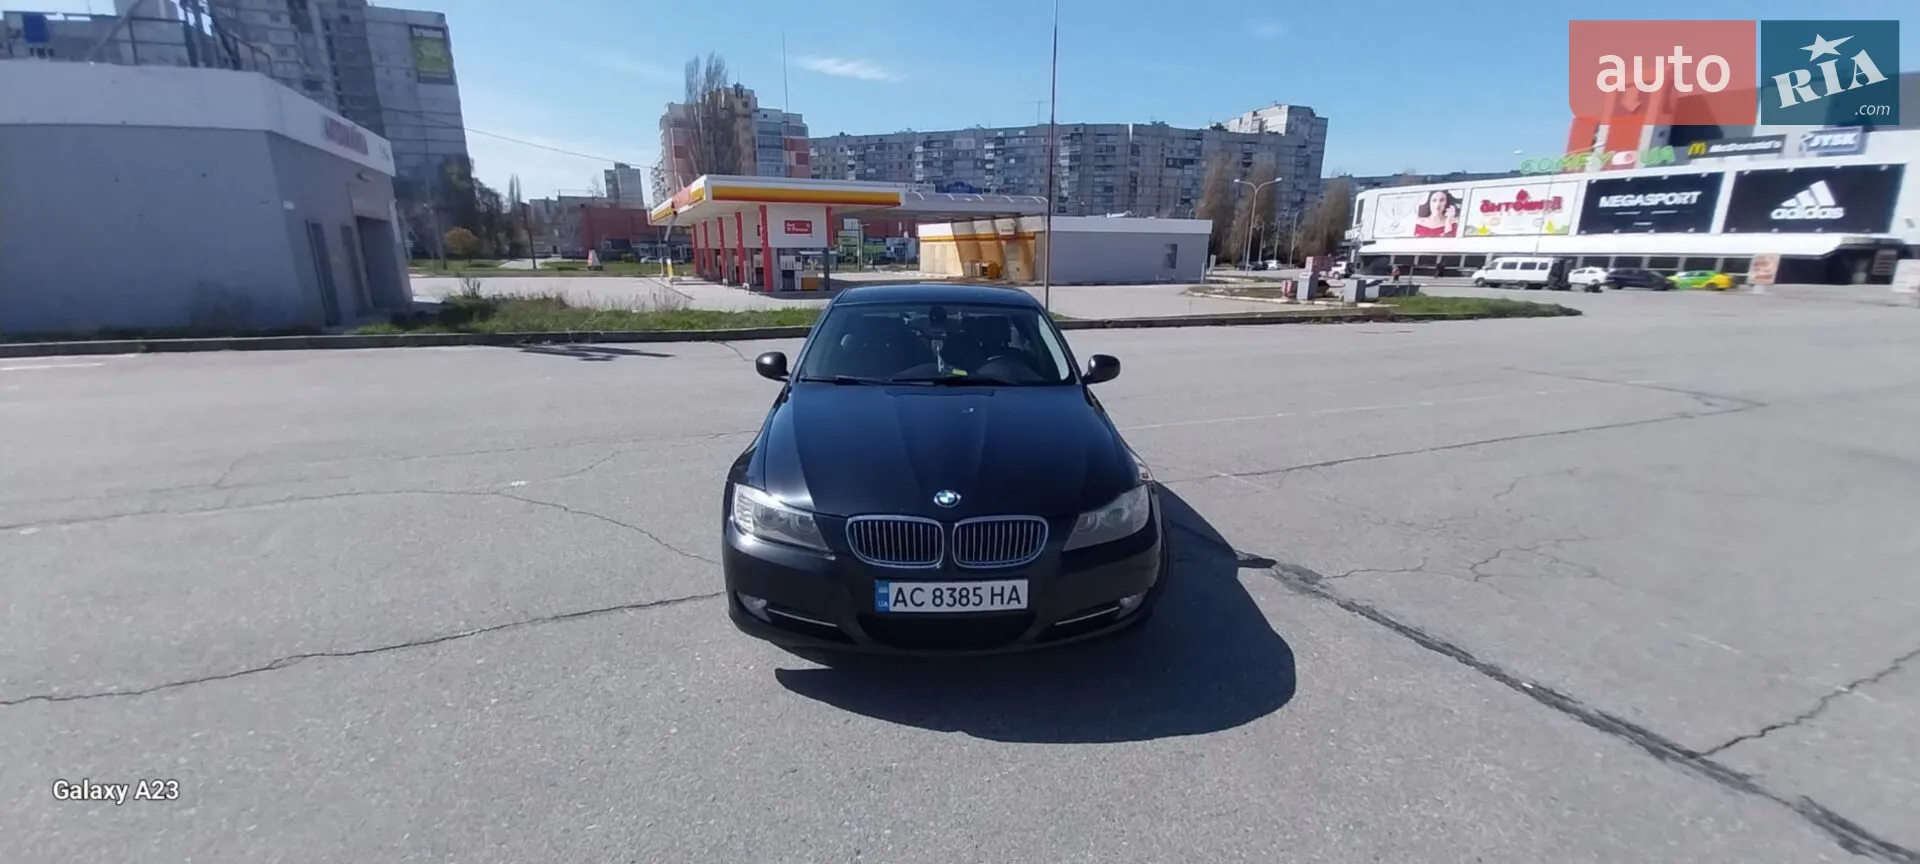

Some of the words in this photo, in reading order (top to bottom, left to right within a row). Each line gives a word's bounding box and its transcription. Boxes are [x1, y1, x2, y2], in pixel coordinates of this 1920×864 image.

[1708, 140, 1782, 153] McDonald's
[1809, 133, 1857, 147] JYSK
[1598, 191, 1702, 208] MEGASPORT
[1770, 206, 1845, 220] adidas
[893, 587, 925, 608] AC
[931, 587, 984, 607] 8385
[990, 585, 1022, 606] HA
